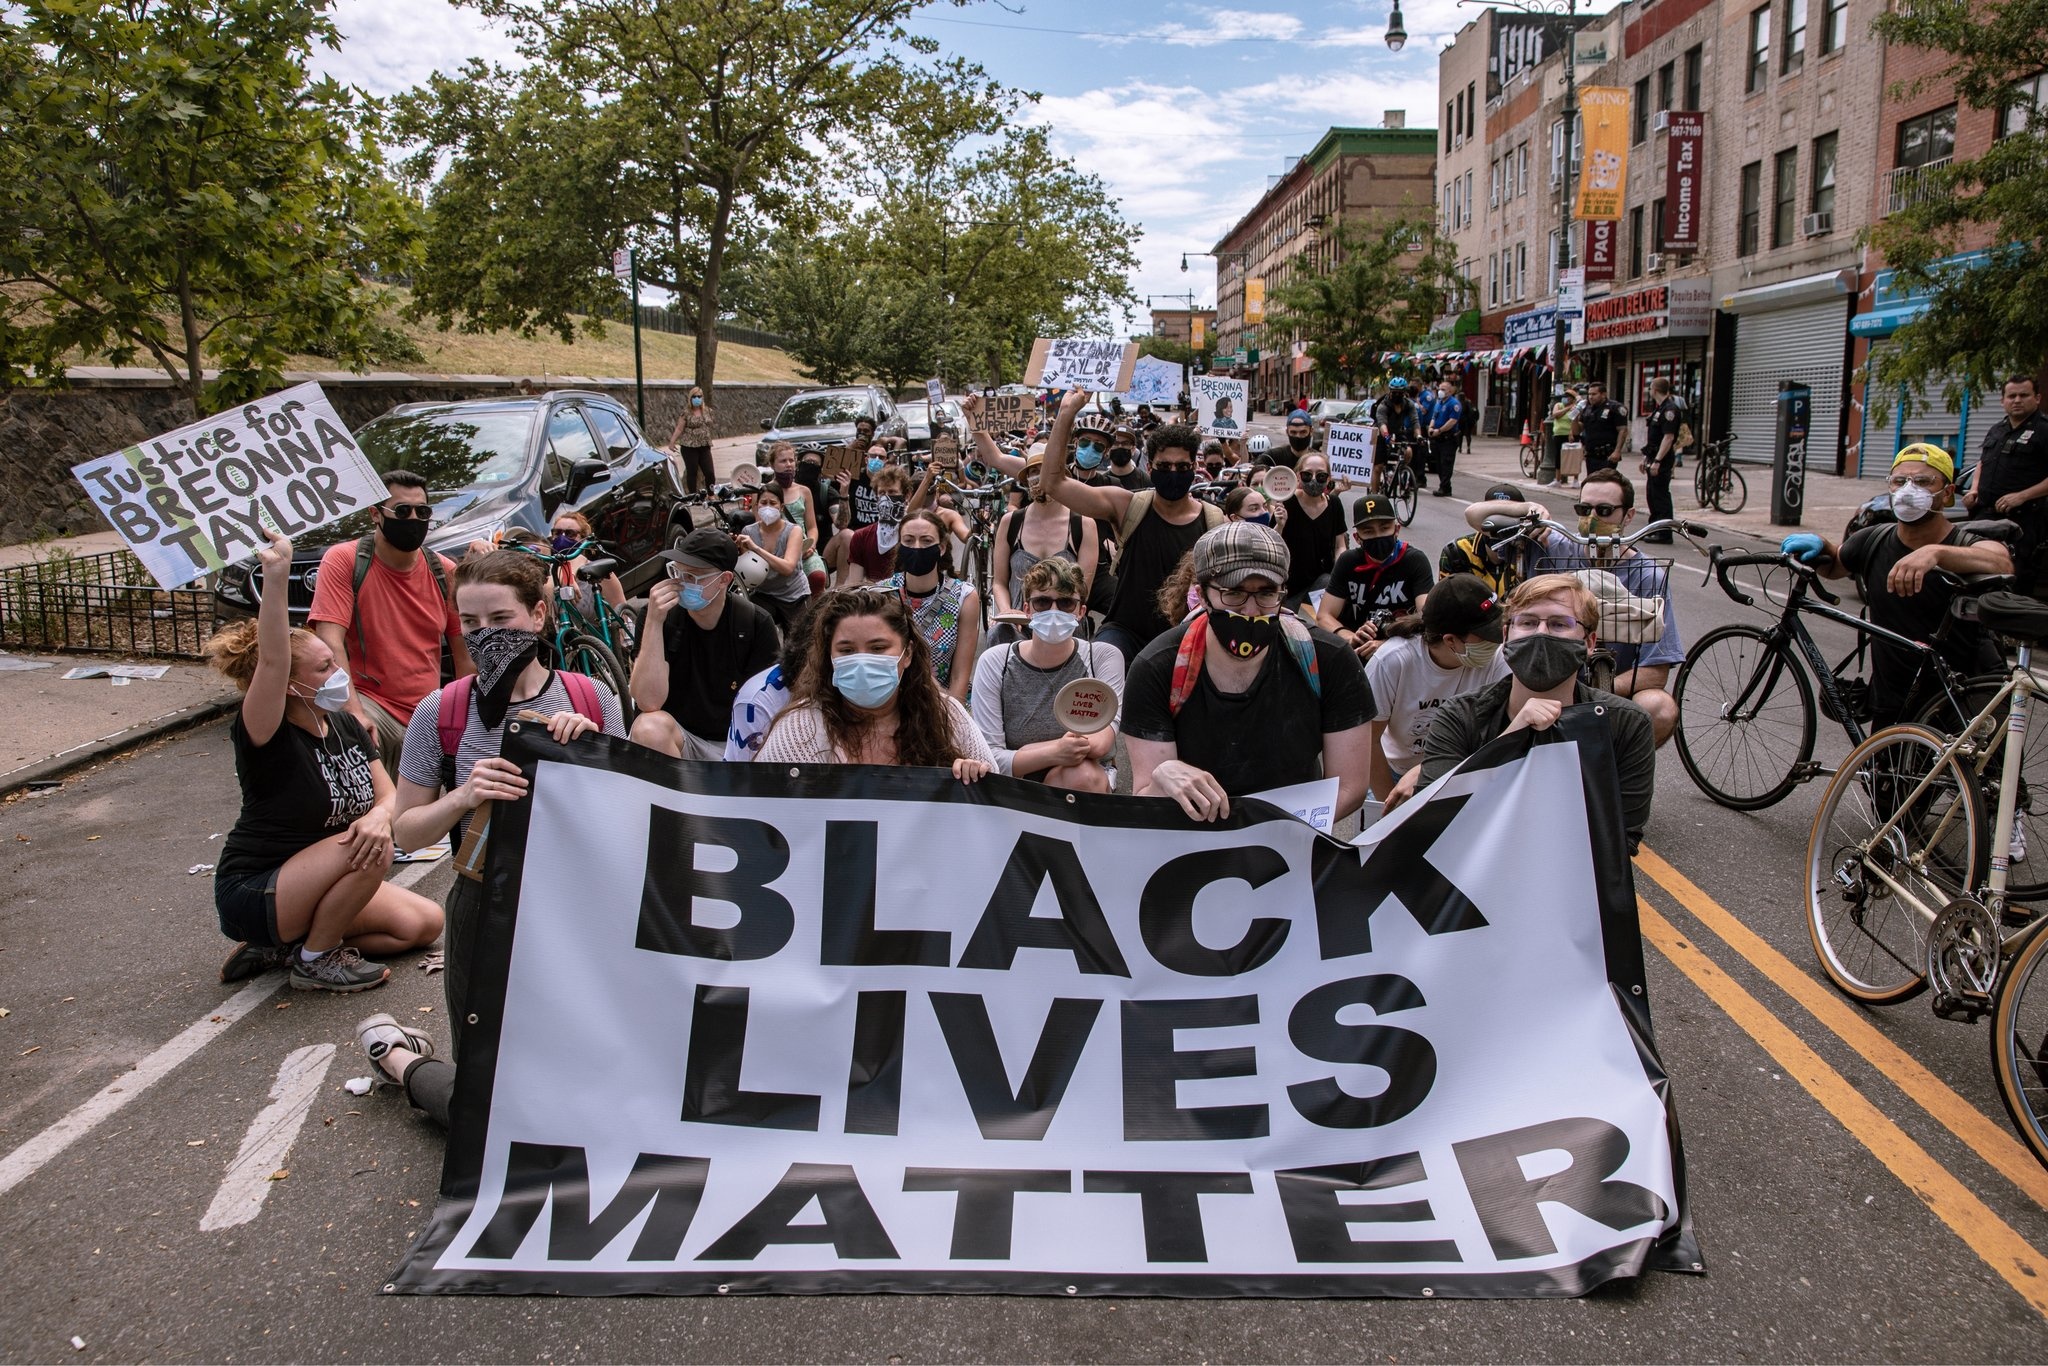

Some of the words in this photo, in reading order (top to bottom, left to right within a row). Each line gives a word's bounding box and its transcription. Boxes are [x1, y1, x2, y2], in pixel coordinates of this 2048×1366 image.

[1583, 93, 1626, 106] SPRING
[1678, 117, 1695, 125] 718
[1677, 141, 1693, 172] Tax
[1674, 176, 1692, 239] Income
[1587, 297, 1625, 324] PAQUITA
[1626, 286, 1666, 316] BELTRE
[1587, 323, 1611, 341] SERVICE
[1611, 319, 1637, 337] CENTER
[1058, 357, 1112, 375] TAYLOR
[1043, 370, 1060, 385] BLM
[1097, 375, 1116, 390] BLM
[1201, 379, 1243, 392] BREONNA
[1203, 390, 1243, 402] TAYLOR
[985, 397, 1021, 412] END
[1794, 400, 1803, 414] P
[972, 409, 1034, 421] WHITE
[971, 419, 1032, 432] SUPREMACY
[1213, 428, 1225, 437] HER
[1330, 429, 1364, 443] BLACK
[83, 427, 241, 506] Justice
[242, 400, 306, 442] for
[826, 448, 860, 471] BLM
[1331, 445, 1363, 460] LIVES
[1331, 462, 1371, 478] MATTER
[109, 418, 356, 544] BREONNA
[855, 486, 877, 500] BLA
[1365, 500, 1376, 513] P
[159, 466, 358, 570] TAYLOR
[1072, 700, 1094, 708] LIVES
[1070, 709, 1099, 718] MATTER
[635, 793, 1490, 979] BLACK
[680, 973, 1438, 1142] LIVES
[464, 1117, 1670, 1263] MATTER
